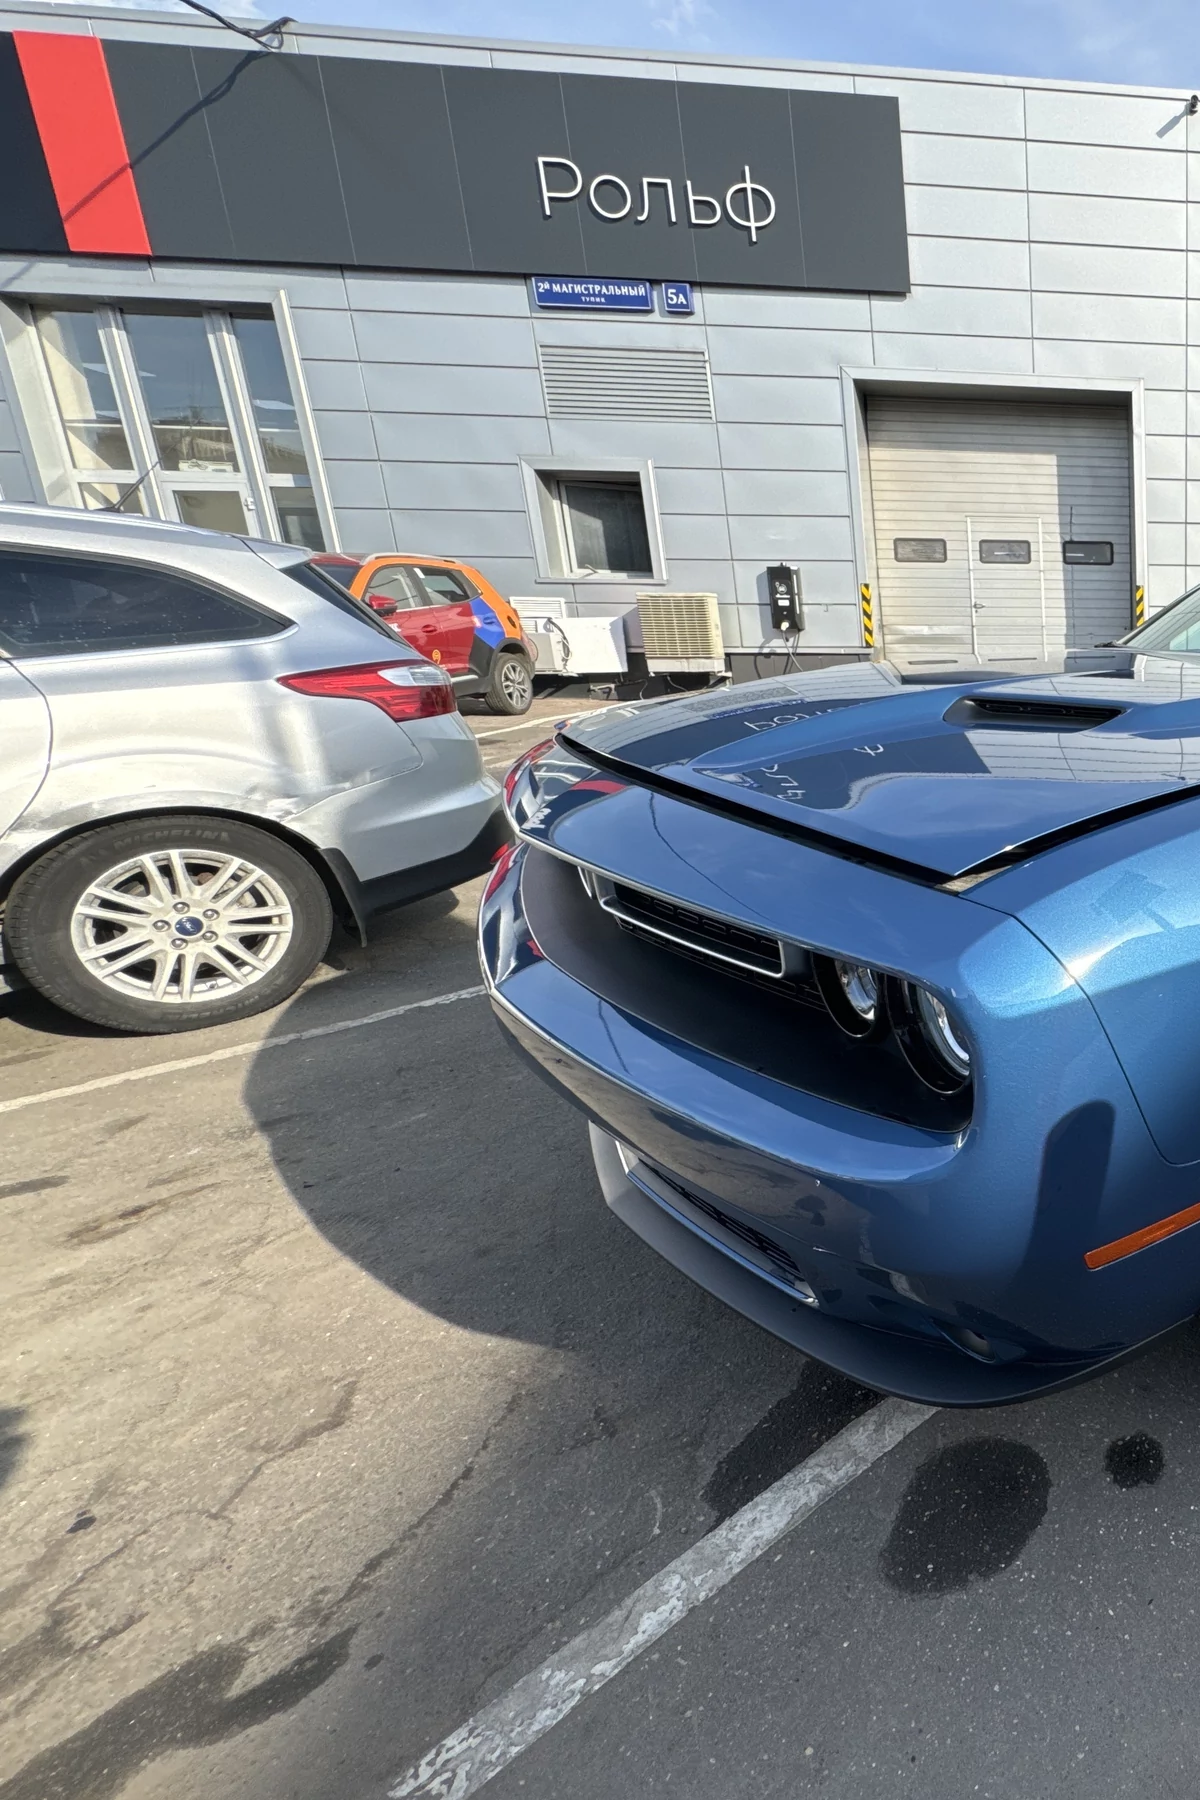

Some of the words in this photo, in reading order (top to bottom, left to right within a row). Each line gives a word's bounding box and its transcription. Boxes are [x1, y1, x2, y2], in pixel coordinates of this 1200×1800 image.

[537, 156, 776, 242] Рольф
[552, 282, 646, 297] МАГИСТРАЛЬНЫЙ
[667, 288, 687, 305] 5А
